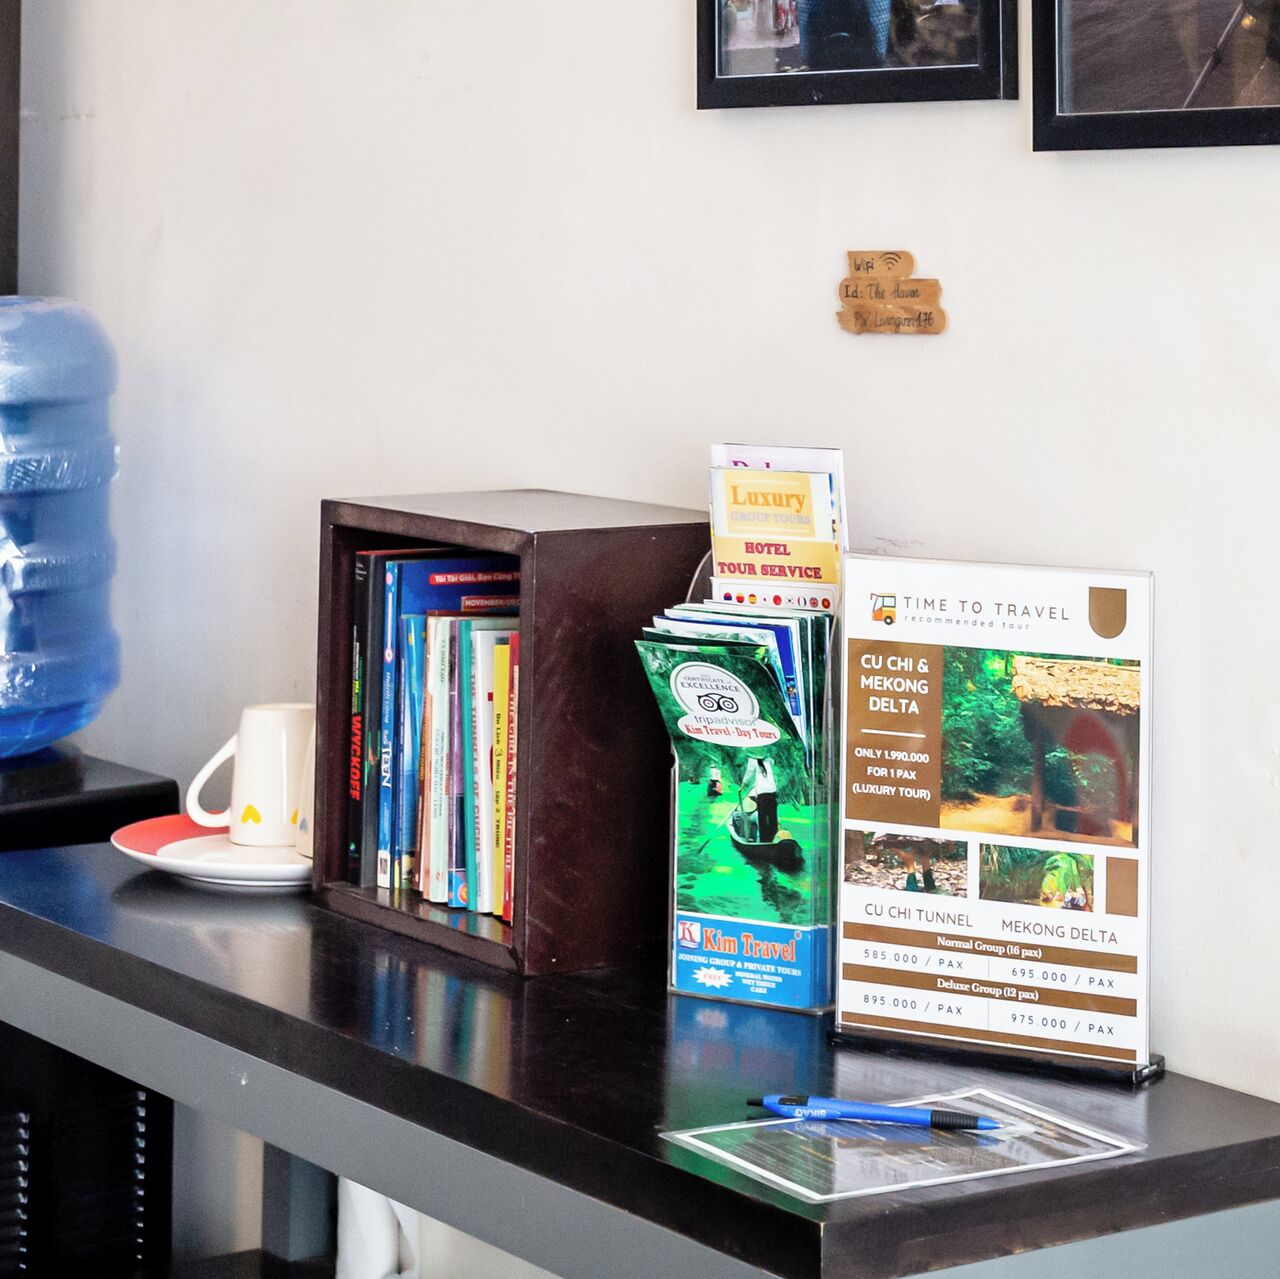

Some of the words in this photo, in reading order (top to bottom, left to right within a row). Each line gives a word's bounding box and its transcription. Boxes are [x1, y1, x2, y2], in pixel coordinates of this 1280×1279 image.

[730, 485, 807, 513] Luxury
[744, 542, 791, 556] HOTEL
[718, 562, 757, 575] TOUR
[760, 564, 822, 579] SERVICE
[904, 596, 948, 612] TIME
[959, 600, 983, 614] TO
[994, 603, 1070, 621] TRAVEL
[904, 615, 994, 628] recommended
[1002, 622, 1031, 630] tour
[860, 654, 883, 669] CU
[887, 656, 913, 672] CHI
[917, 658, 929, 673] &
[681, 681, 741, 692] EXCELLENCE
[860, 675, 929, 694] MEKONG
[869, 696, 920, 715] DELTA
[694, 714, 756, 726] tripadvisor
[684, 724, 703, 734] Kim
[703, 725, 731, 736] Travel
[735, 727, 752, 739] Day
[752, 728, 778, 739] Tours
[351, 715, 362, 800] WYCKOFF
[382, 741, 393, 788] TEEN
[854, 747, 882, 759] ONLY
[883, 750, 929, 764] 1.990.000
[867, 766, 888, 778] FOR
[890, 768, 895, 778] 1
[896, 769, 917, 781] PAX
[852, 783, 896, 796] (LUXURY
[898, 786, 931, 801] TOUR)
[864, 903, 884, 917] CU
[888, 906, 911, 920] CHI
[916, 908, 974, 928] TUNNEL
[1001, 919, 1066, 938] MEKONG
[1071, 927, 1118, 944] DELTA
[703, 928, 737, 954] Kim
[742, 932, 796, 962] Travel
[937, 935, 973, 949] Normal
[974, 941, 1006, 956] Group
[1006, 944, 1020, 956] (16
[1021, 947, 1043, 960] pax)
[709, 957, 736, 967] GROUP
[744, 962, 776, 973] PRIVATE
[777, 966, 802, 976] TOURS
[864, 948, 918, 964] 585.000
[925, 956, 931, 967] /
[938, 958, 964, 970] PAX
[1012, 967, 1067, 983] 695.000
[1074, 974, 1081, 986] /
[1089, 976, 1115, 989] PAX
[937, 978, 971, 992] Deluxe
[971, 983, 1003, 998] Group
[1003, 986, 1017, 998] (12
[1017, 990, 1040, 1002] pax)
[863, 994, 918, 1010] 895.000
[924, 1001, 931, 1013] /
[937, 1003, 963, 1016] PAX
[1011, 1013, 1067, 1030] 975.000
[1074, 1021, 1081, 1032] /
[1088, 1023, 1115, 1036] PAX
